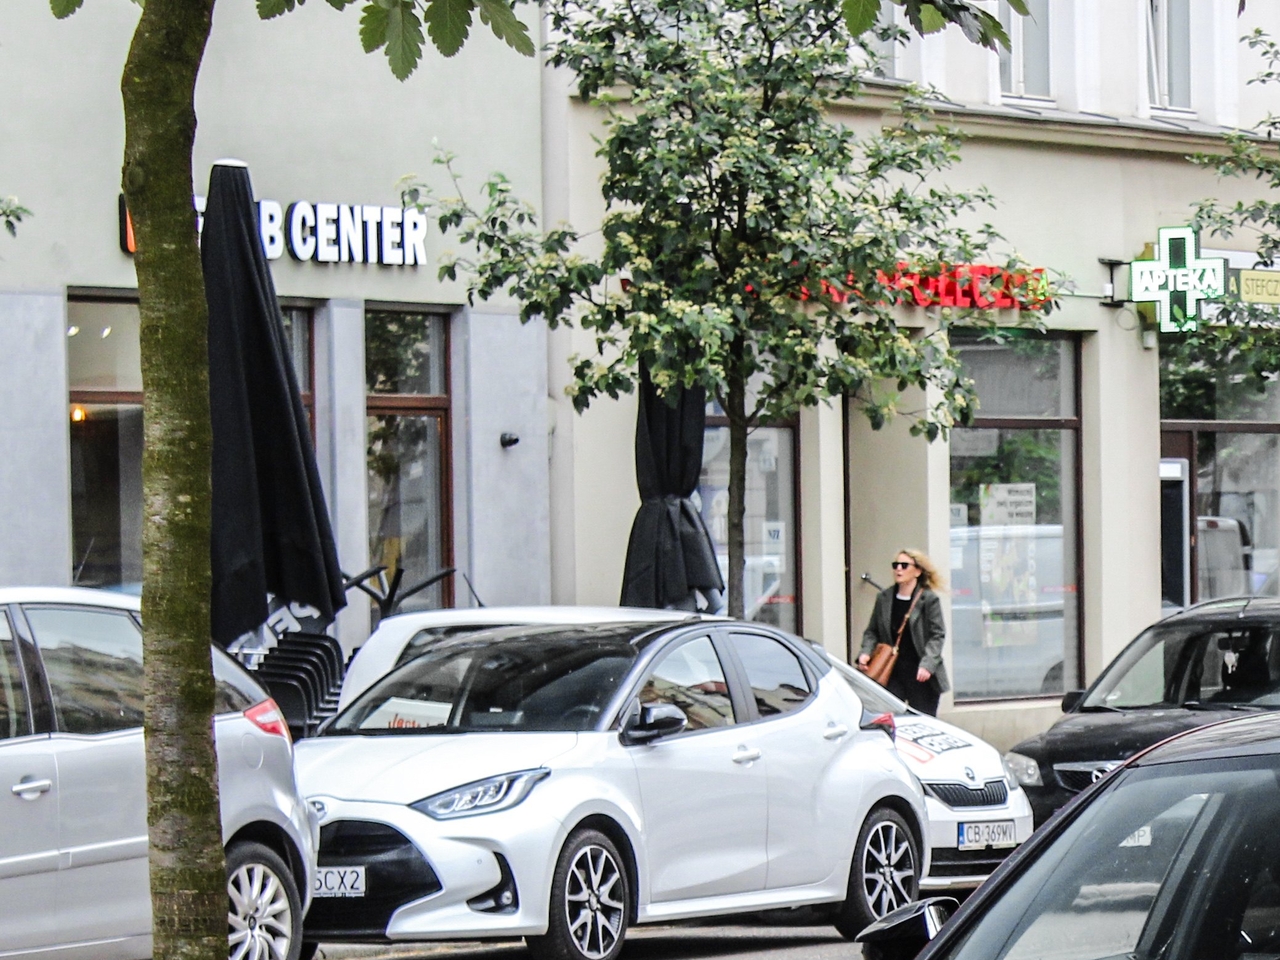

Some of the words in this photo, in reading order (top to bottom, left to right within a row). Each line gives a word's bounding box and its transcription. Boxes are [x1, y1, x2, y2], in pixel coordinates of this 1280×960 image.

[290, 201, 427, 266] CENTER
[1140, 268, 1218, 292] APTEKA
[966, 825, 981, 843] CB
